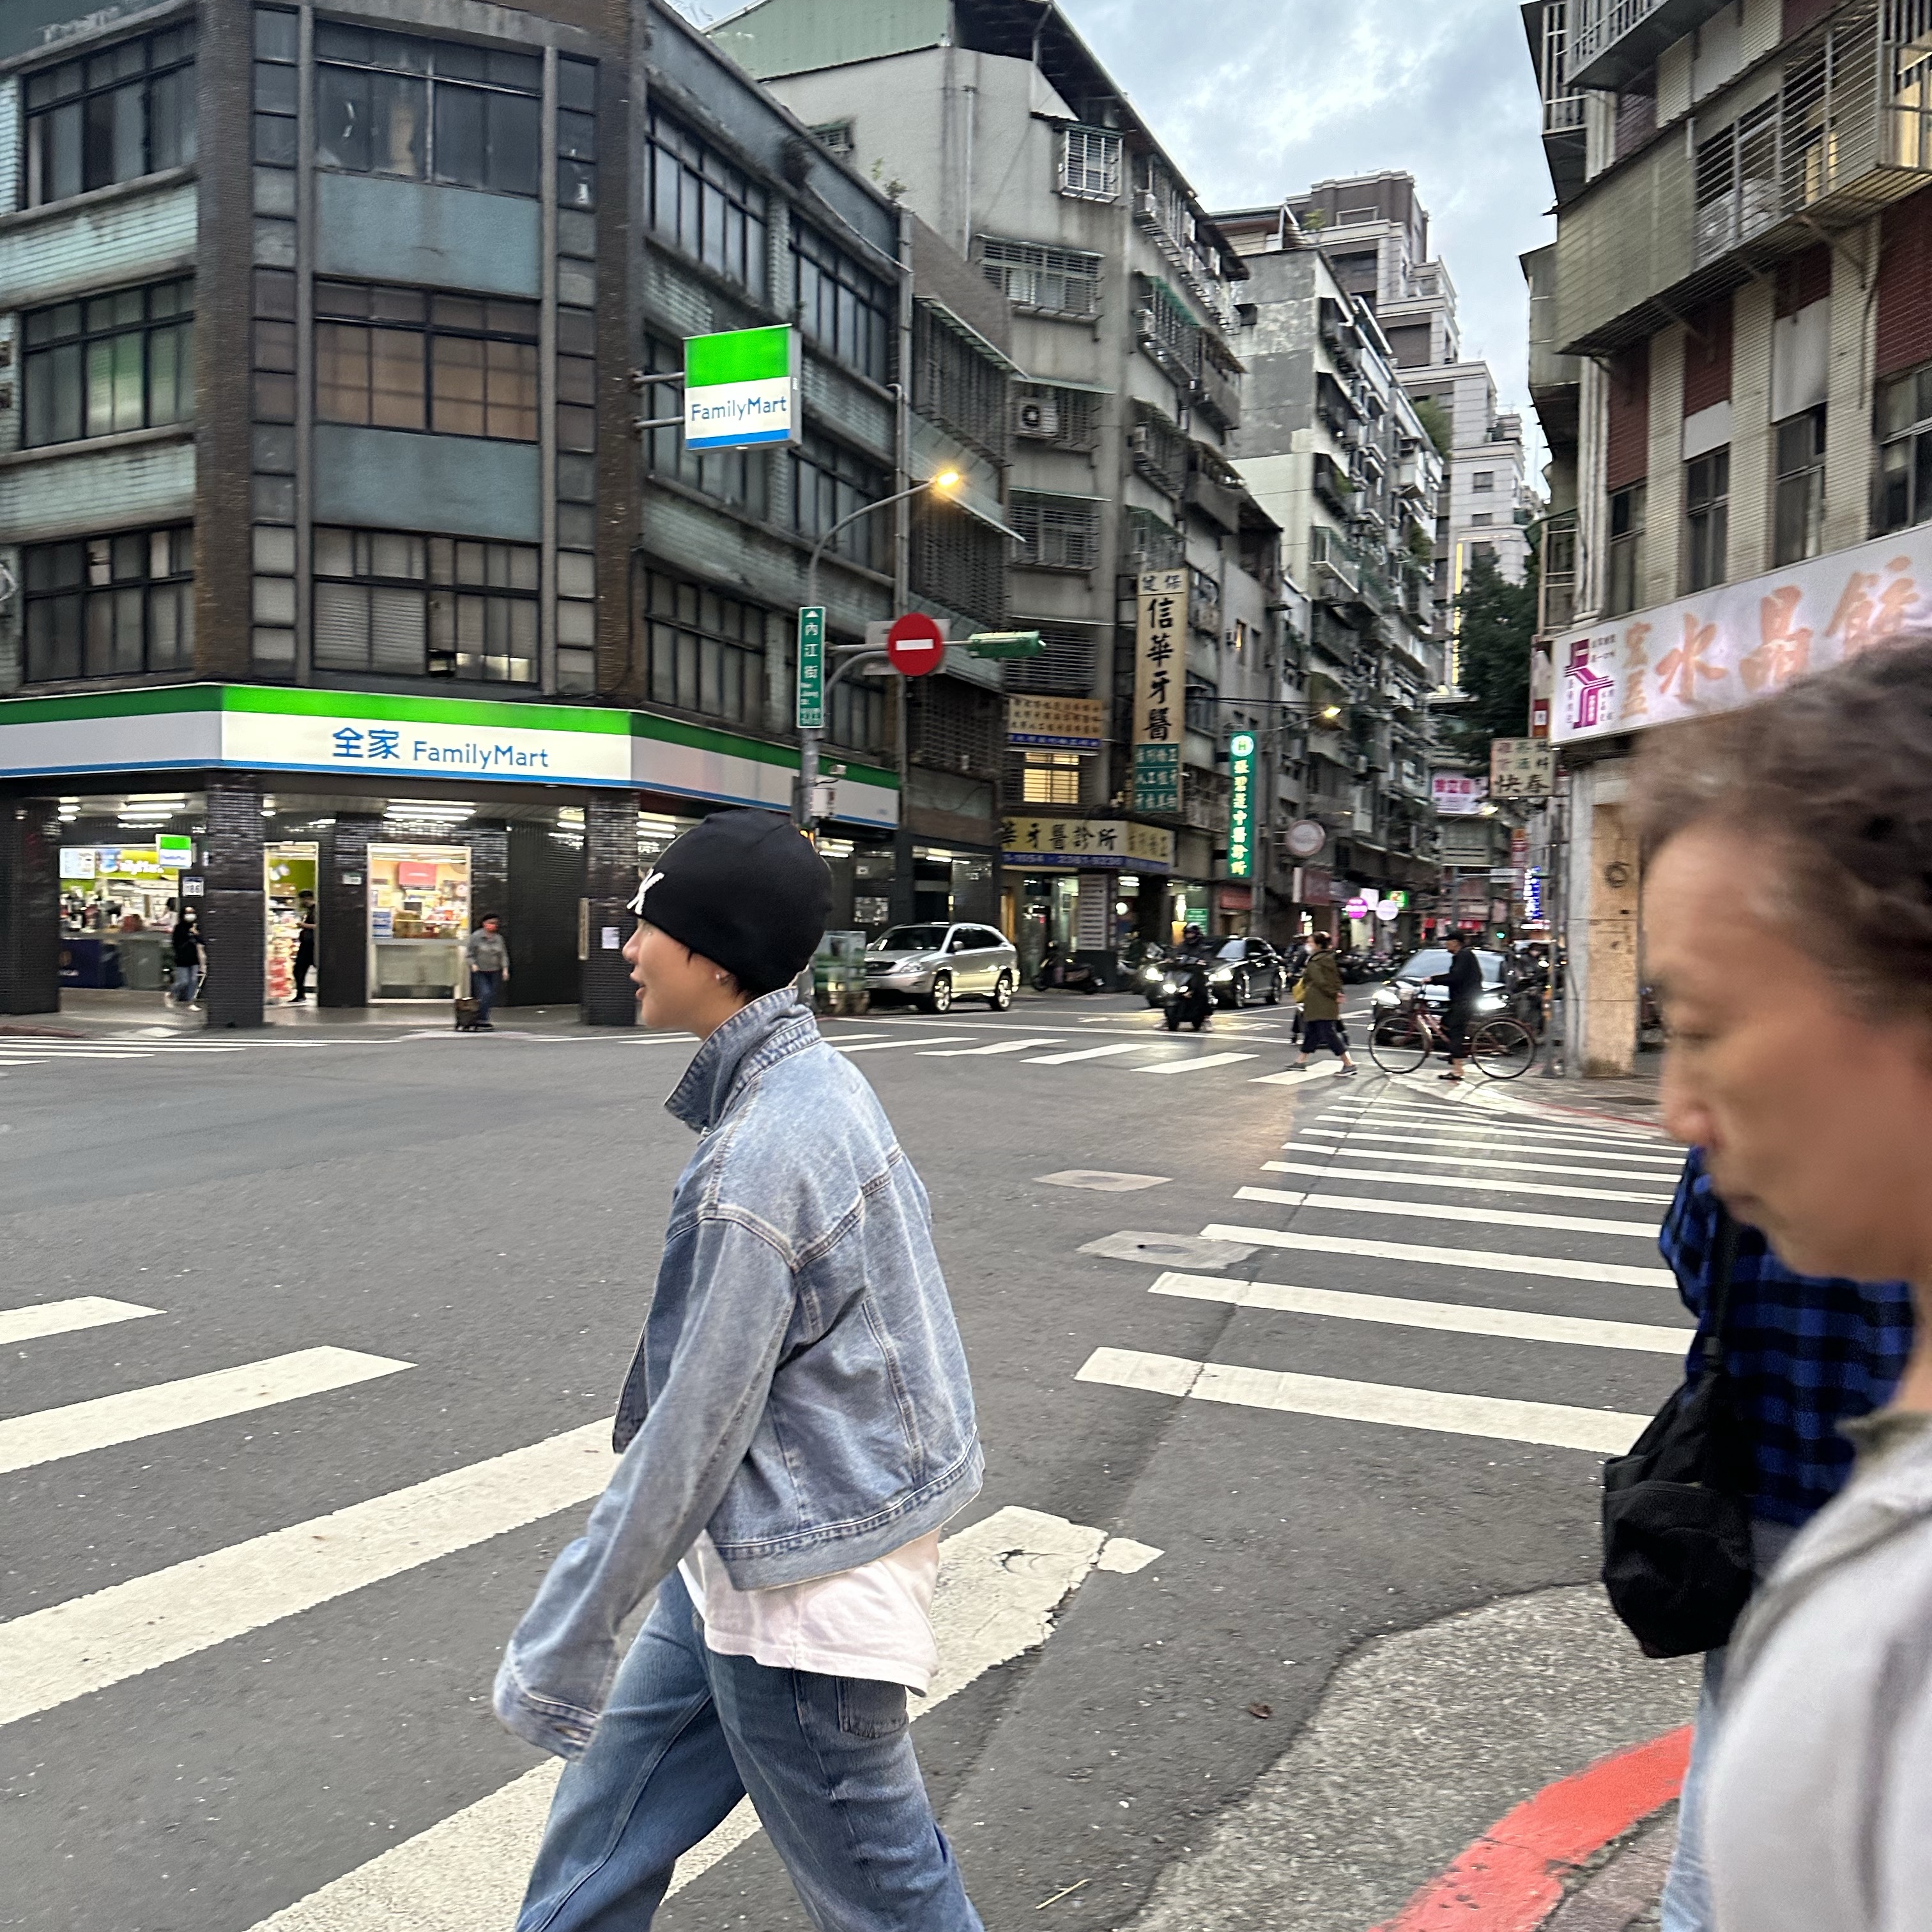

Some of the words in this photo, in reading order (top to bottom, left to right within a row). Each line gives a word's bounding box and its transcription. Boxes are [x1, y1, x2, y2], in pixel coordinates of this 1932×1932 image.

[691, 396, 786, 422] FamilyMart
[1143, 597, 1174, 741] 信華牙醫
[332, 727, 401, 760] 全家
[413, 740, 549, 770] FamilyMart
